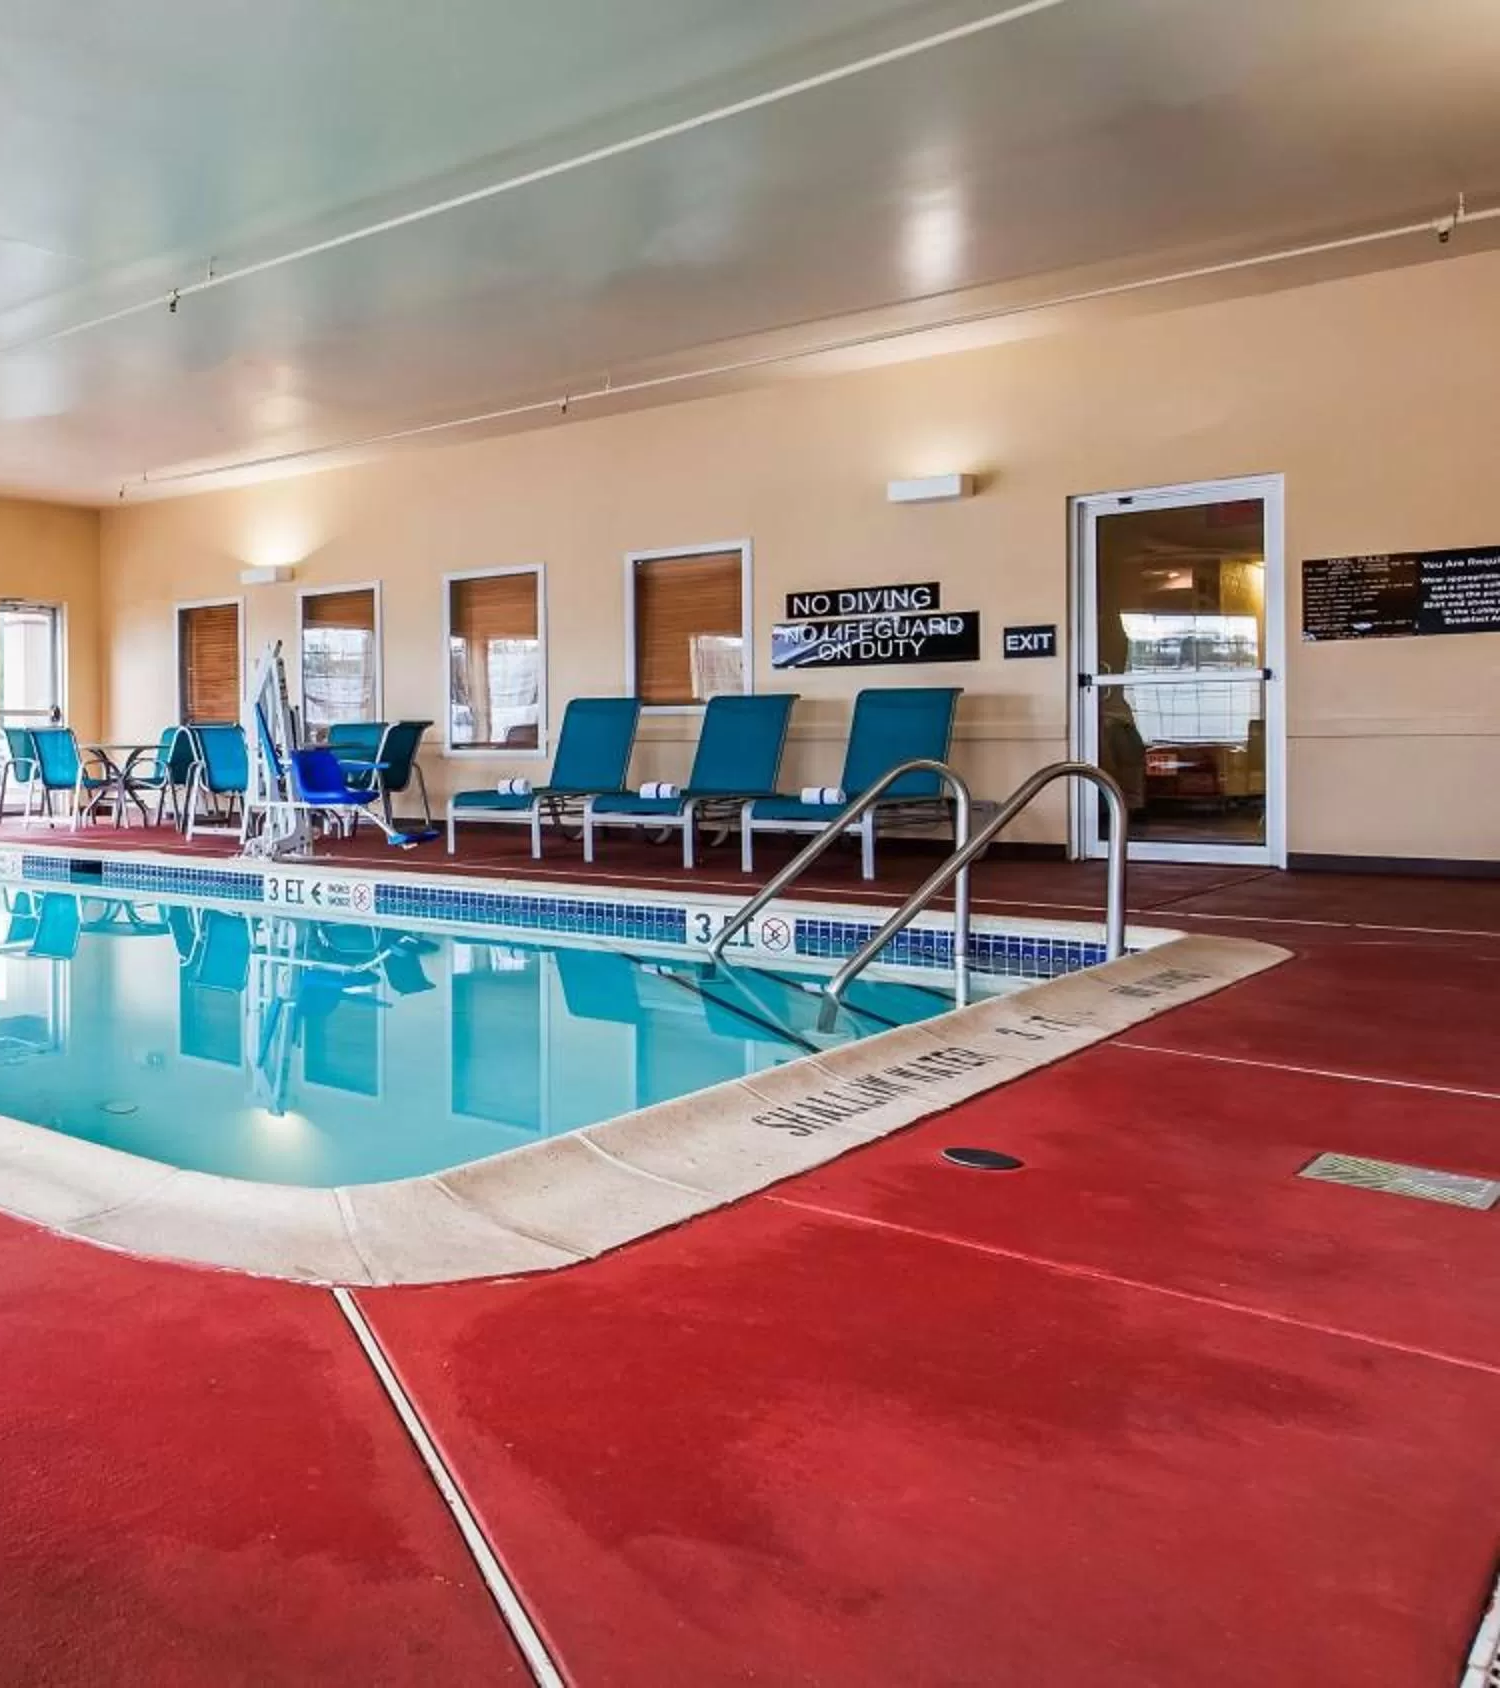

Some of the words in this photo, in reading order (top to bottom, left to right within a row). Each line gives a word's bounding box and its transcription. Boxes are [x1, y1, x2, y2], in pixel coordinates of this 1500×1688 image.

[1421, 560, 1443, 569] You
[1445, 559, 1465, 567] Are
[792, 593, 831, 616] NO
[839, 587, 932, 614] DIVING
[785, 624, 818, 643] NO
[824, 616, 965, 641] LIFEGUARD
[1005, 633, 1053, 651] EXIT
[818, 642, 851, 661] ON
[859, 637, 926, 659] DUTY
[695, 913, 711, 944] 3
